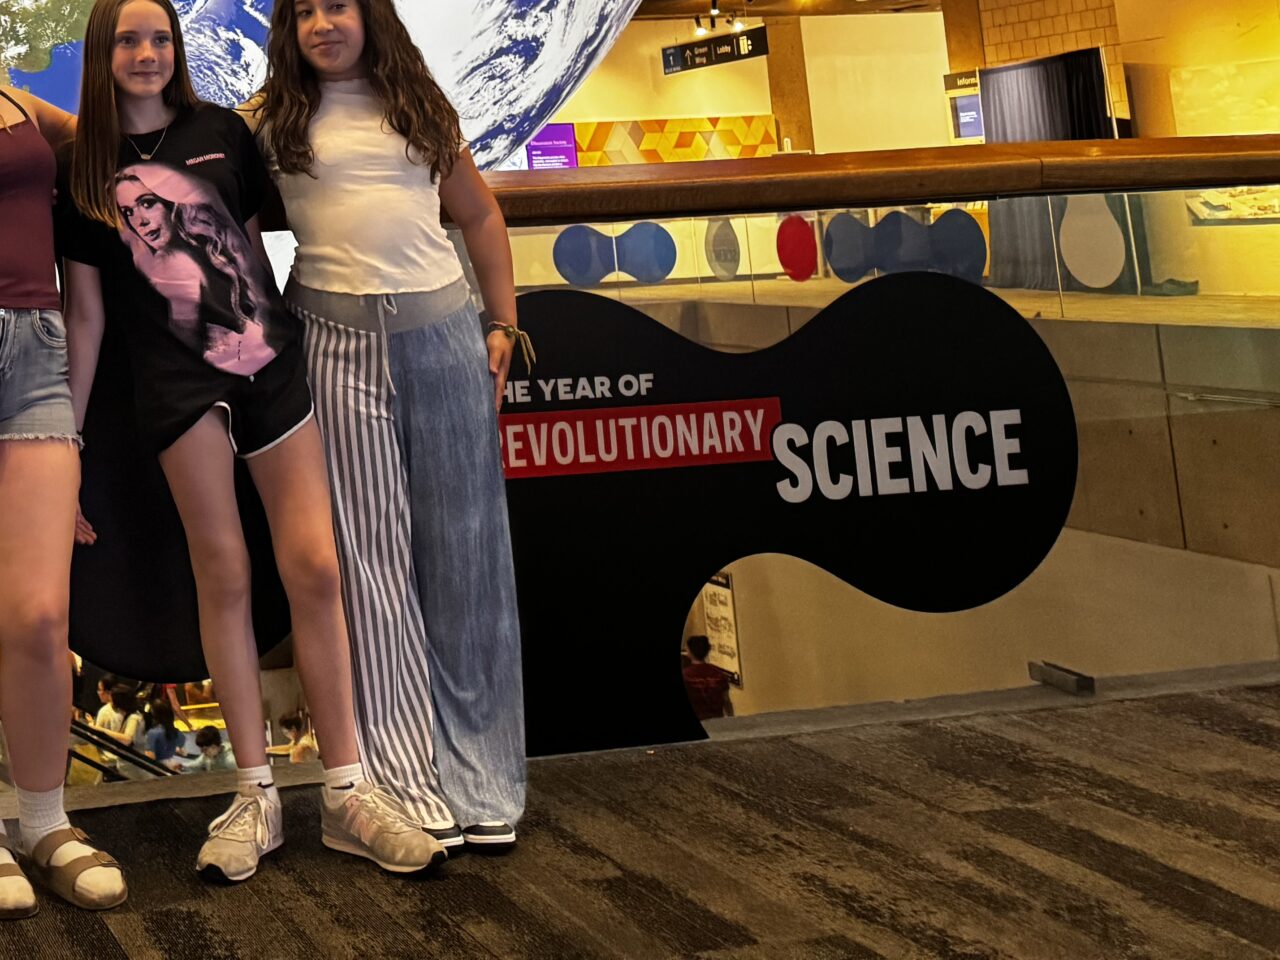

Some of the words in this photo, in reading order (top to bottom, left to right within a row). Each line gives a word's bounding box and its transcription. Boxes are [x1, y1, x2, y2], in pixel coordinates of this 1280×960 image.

[716, 44, 731, 54] Lobby
[504, 380, 532, 403] HE
[537, 376, 612, 401] YEAR
[618, 373, 654, 397] OF
[772, 409, 1029, 504] SCIENCE
